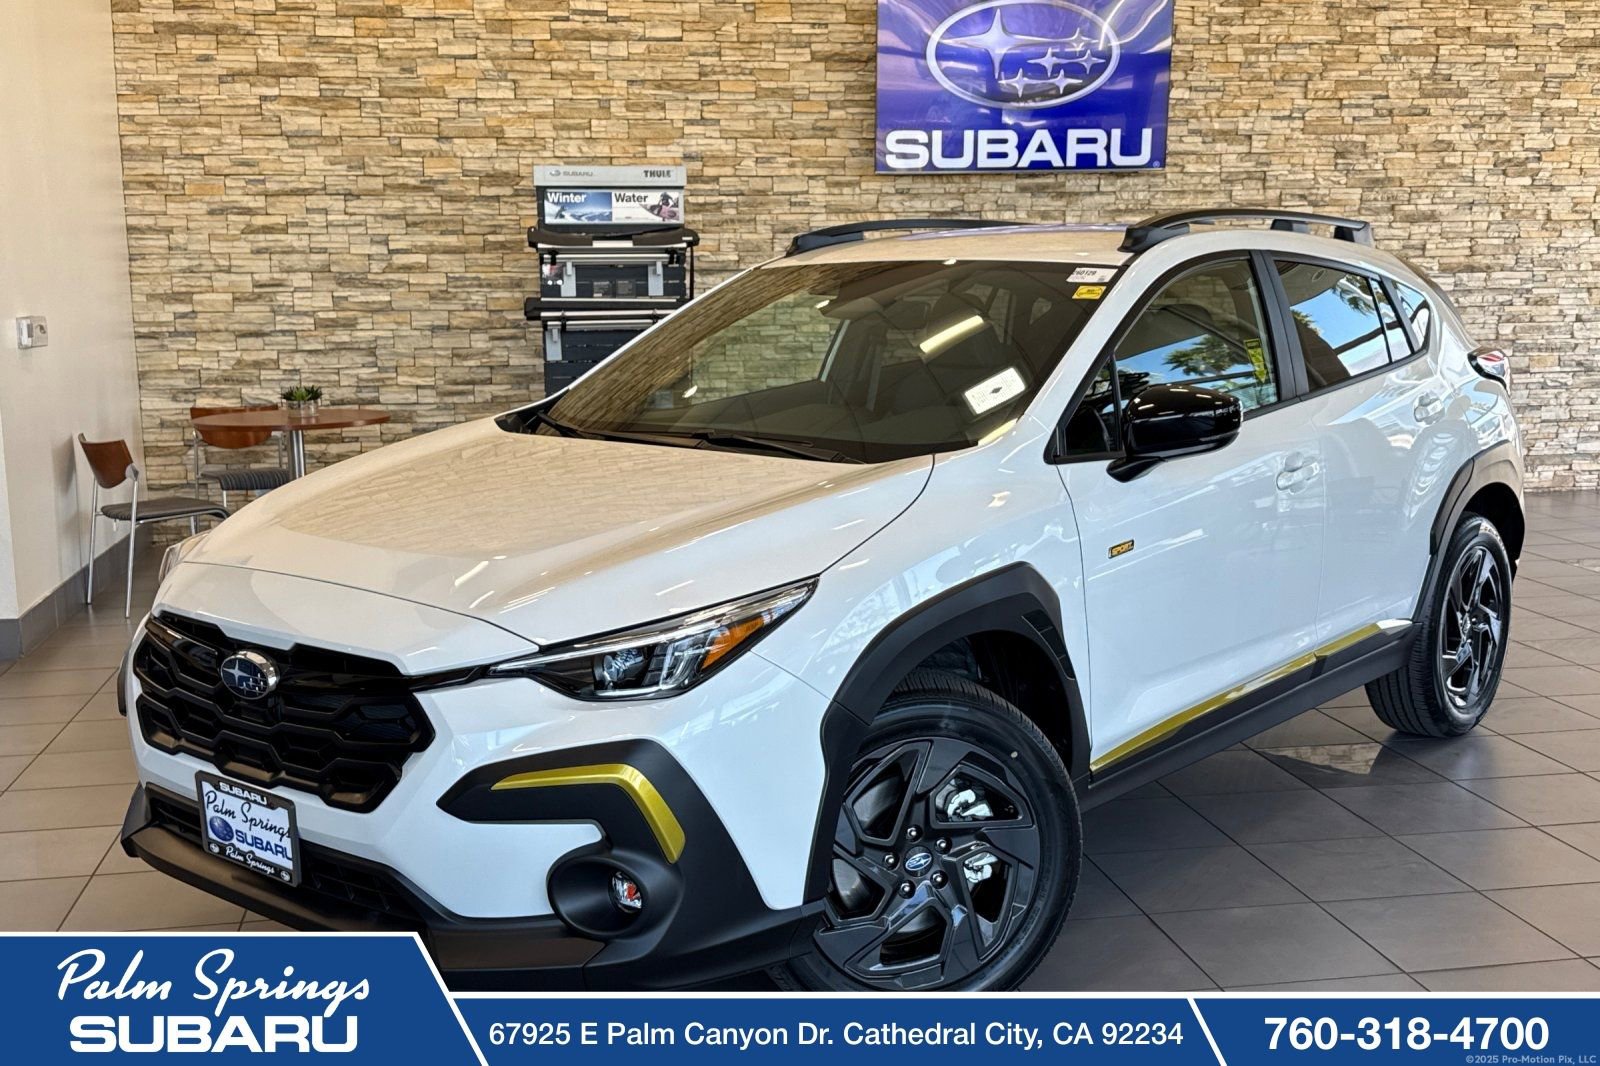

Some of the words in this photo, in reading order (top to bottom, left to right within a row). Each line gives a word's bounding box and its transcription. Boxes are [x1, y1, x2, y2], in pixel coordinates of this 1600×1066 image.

[885, 128, 1153, 169] SUBARU
[562, 170, 594, 178] SUBARU
[643, 169, 672, 178] THULE
[546, 191, 588, 204] Winter
[614, 192, 649, 203] Water
[219, 782, 268, 806] SUBARU
[204, 790, 237, 819] Palm
[240, 801, 291, 842] Springs
[225, 845, 244, 862] Palm
[245, 852, 275, 875] Springs
